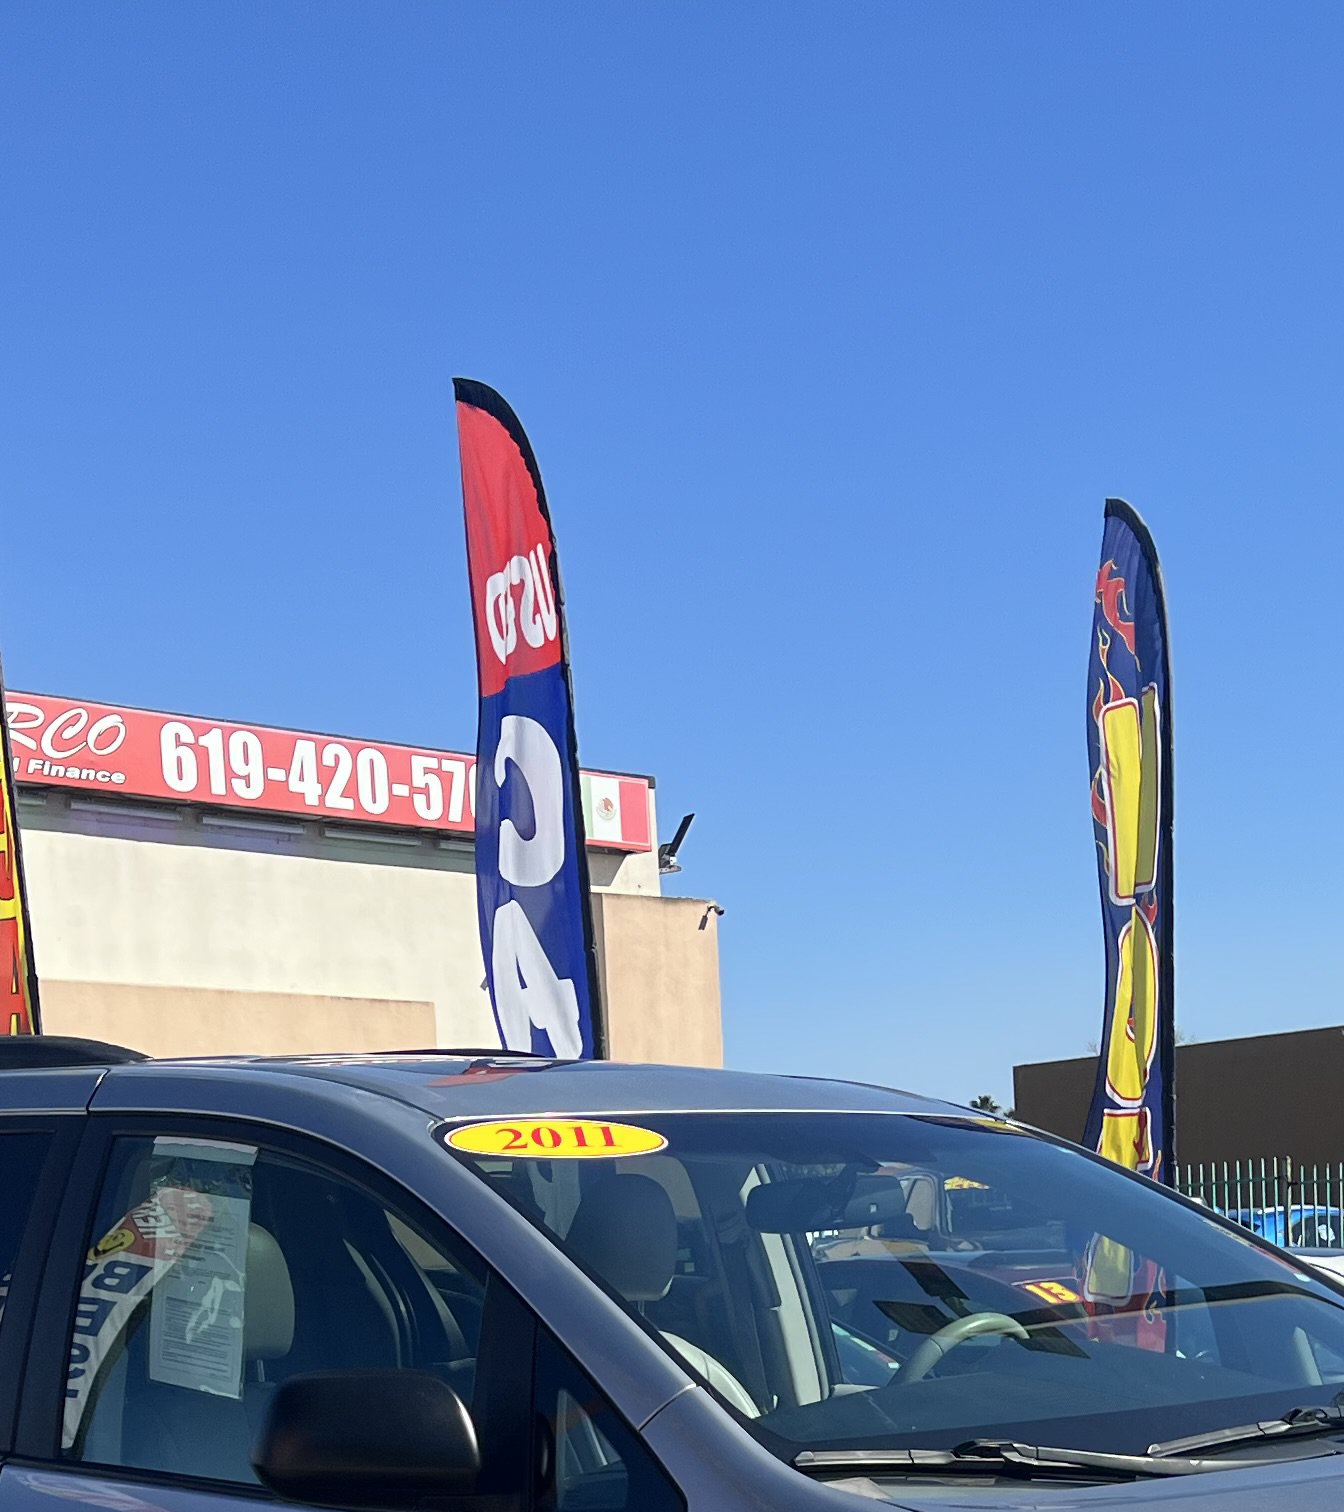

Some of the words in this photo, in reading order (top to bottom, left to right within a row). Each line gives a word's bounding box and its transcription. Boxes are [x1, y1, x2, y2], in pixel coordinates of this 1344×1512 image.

[27, 758, 126, 784] Finance
[159, 721, 477, 825] 619-420-57
[495, 1126, 620, 1150] 2011
